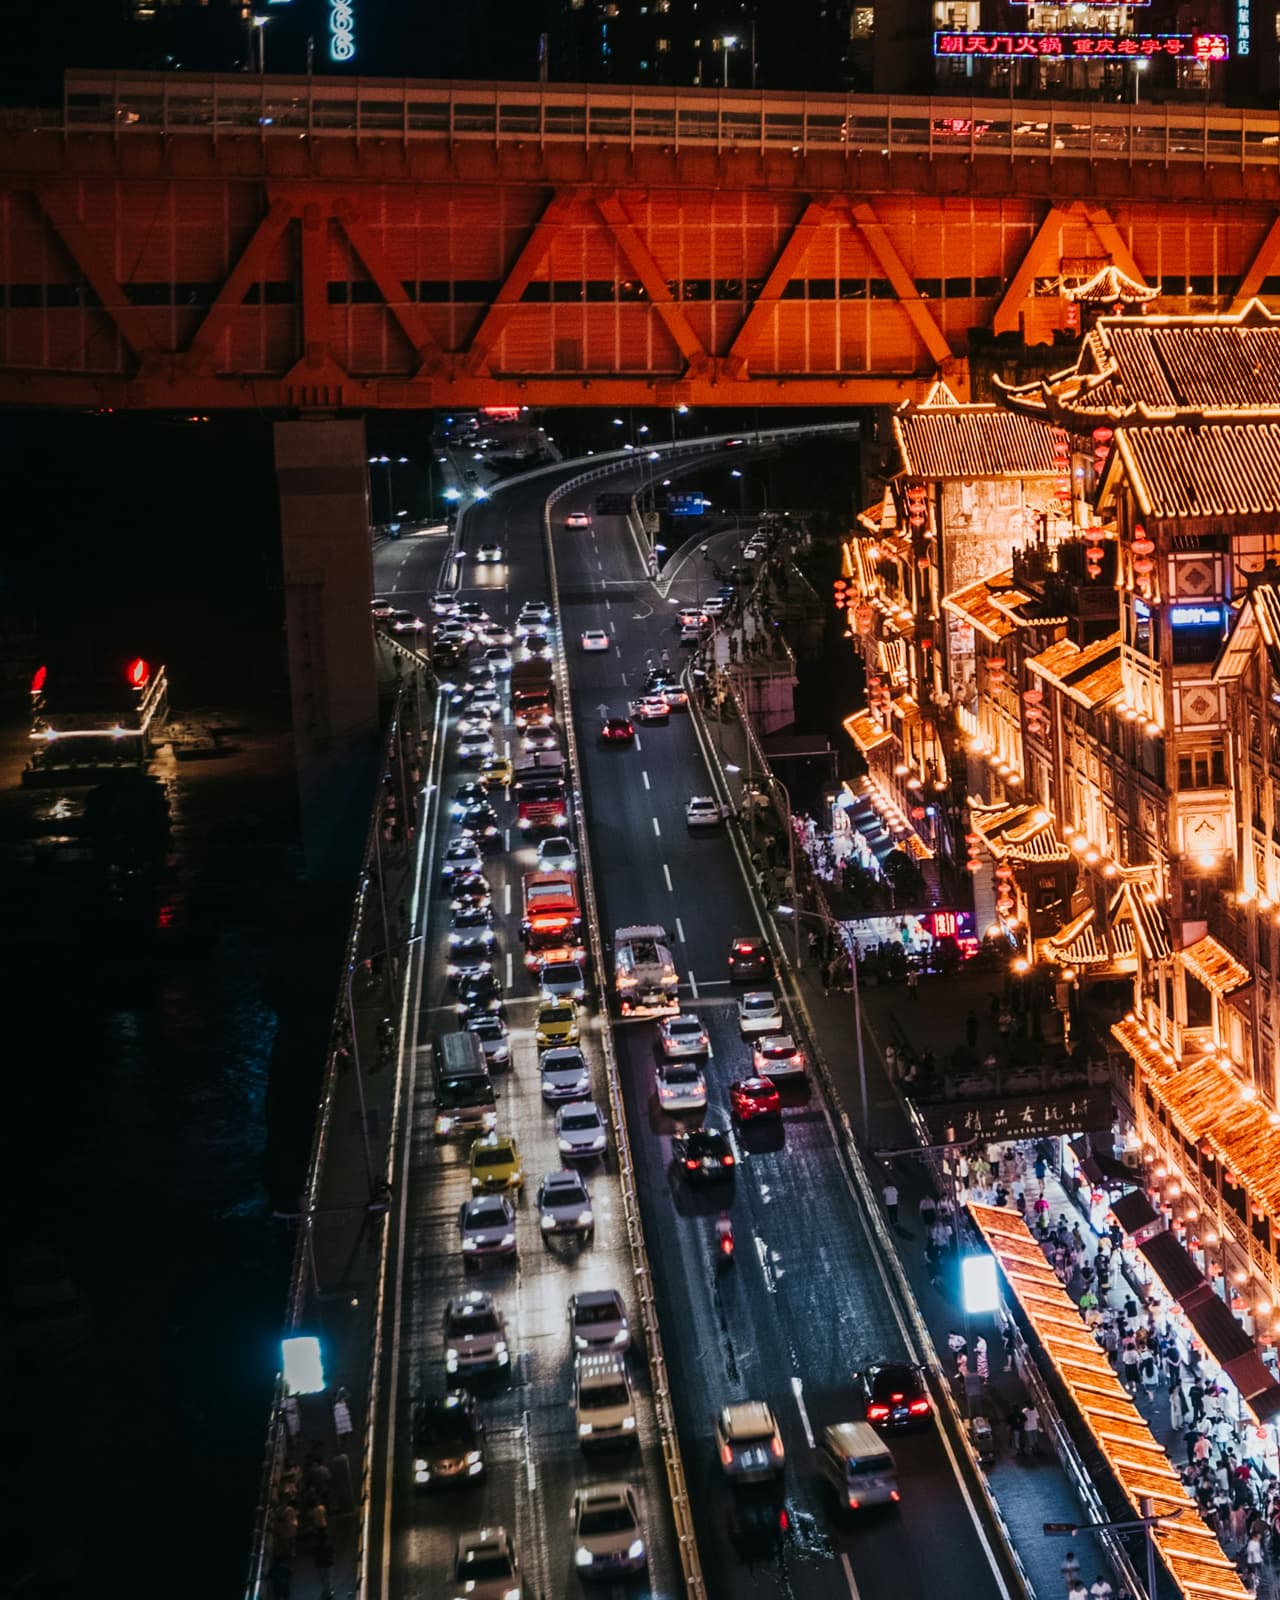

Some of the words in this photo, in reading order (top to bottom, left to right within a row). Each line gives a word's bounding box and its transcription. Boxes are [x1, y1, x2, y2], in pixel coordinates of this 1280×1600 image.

[940, 36, 1062, 53] 朝天门火锅
